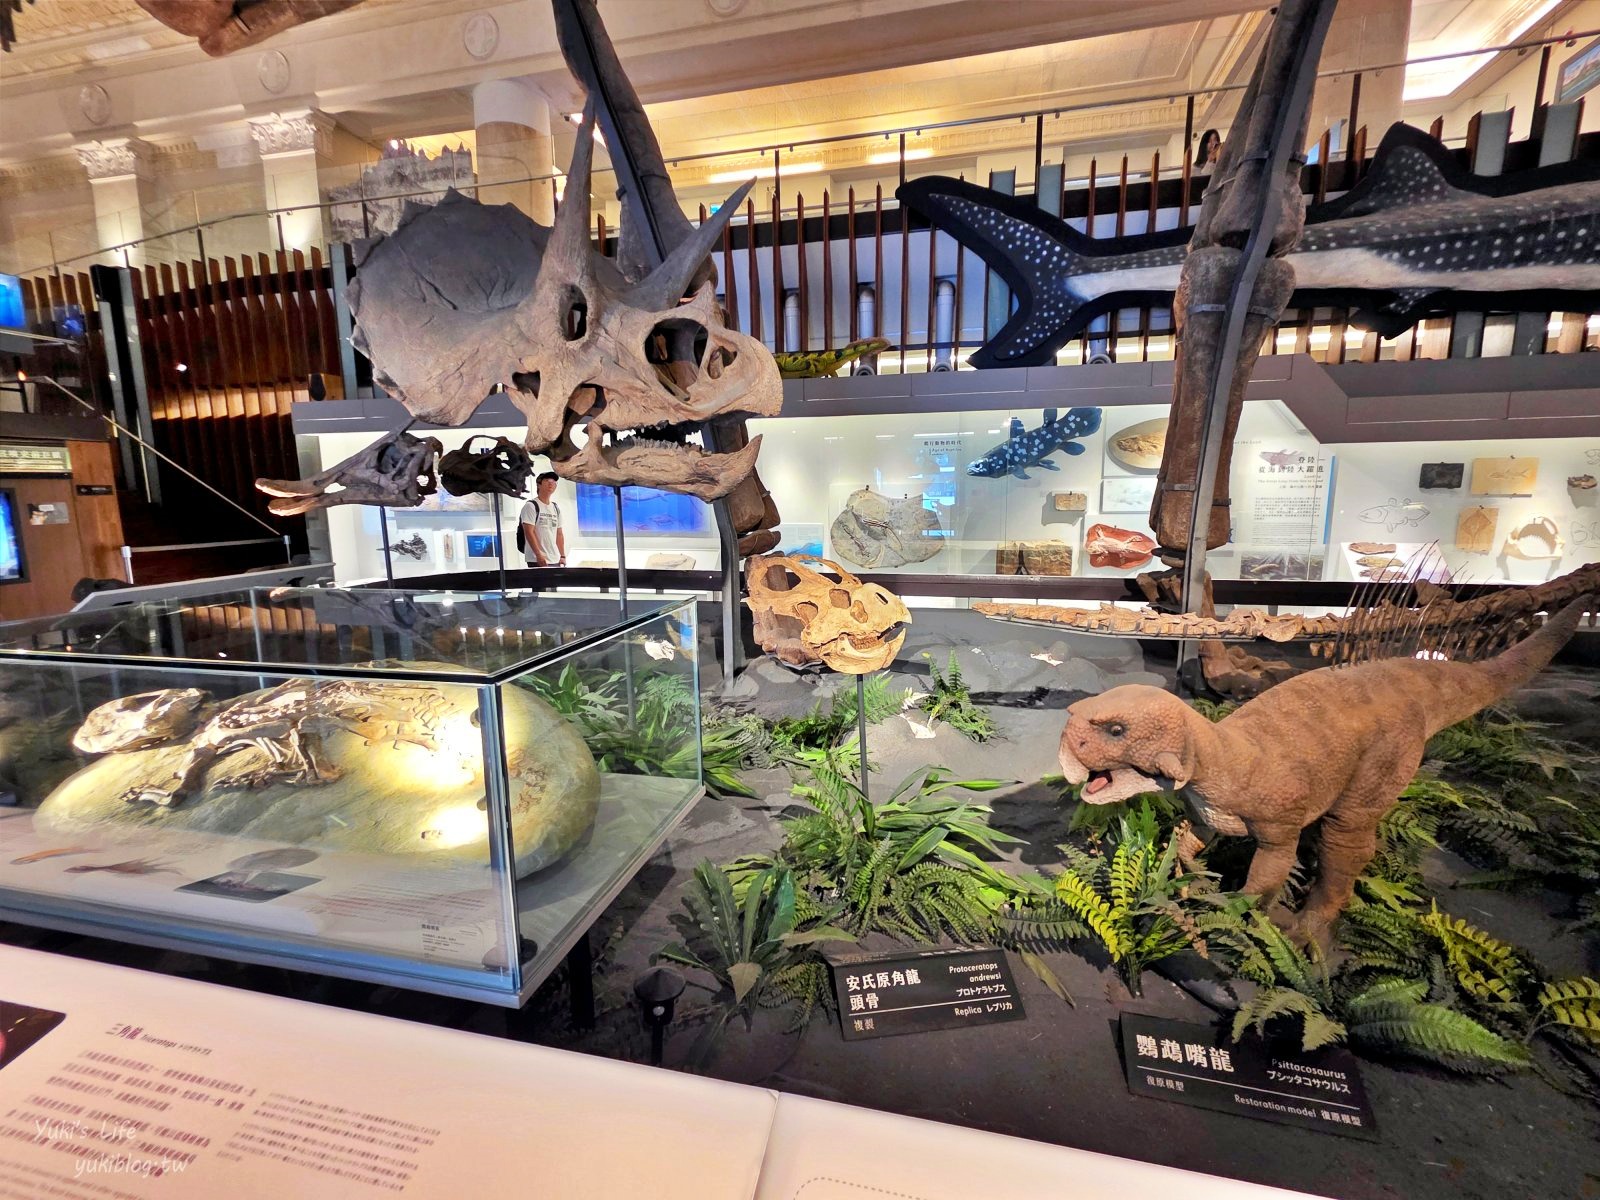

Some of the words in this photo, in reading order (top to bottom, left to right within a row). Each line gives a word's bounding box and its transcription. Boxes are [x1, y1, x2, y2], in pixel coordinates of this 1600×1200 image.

[949, 963, 998, 974] Protoceratops
[969, 972, 1002, 983] andrewsi
[845, 968, 921, 992] 安氏原角龍
[849, 992, 880, 1011] 頭骨
[954, 1006, 983, 1017] Replica
[986, 1001, 1013, 1013] レプリカ
[853, 1018, 875, 1032] 複製
[1136, 1034, 1235, 1073] 鸚鵡嘴龍
[1272, 1058, 1347, 1080] Psittacosaurus
[1234, 1094, 1286, 1112] Restoration
[1287, 1106, 1317, 1118] model
